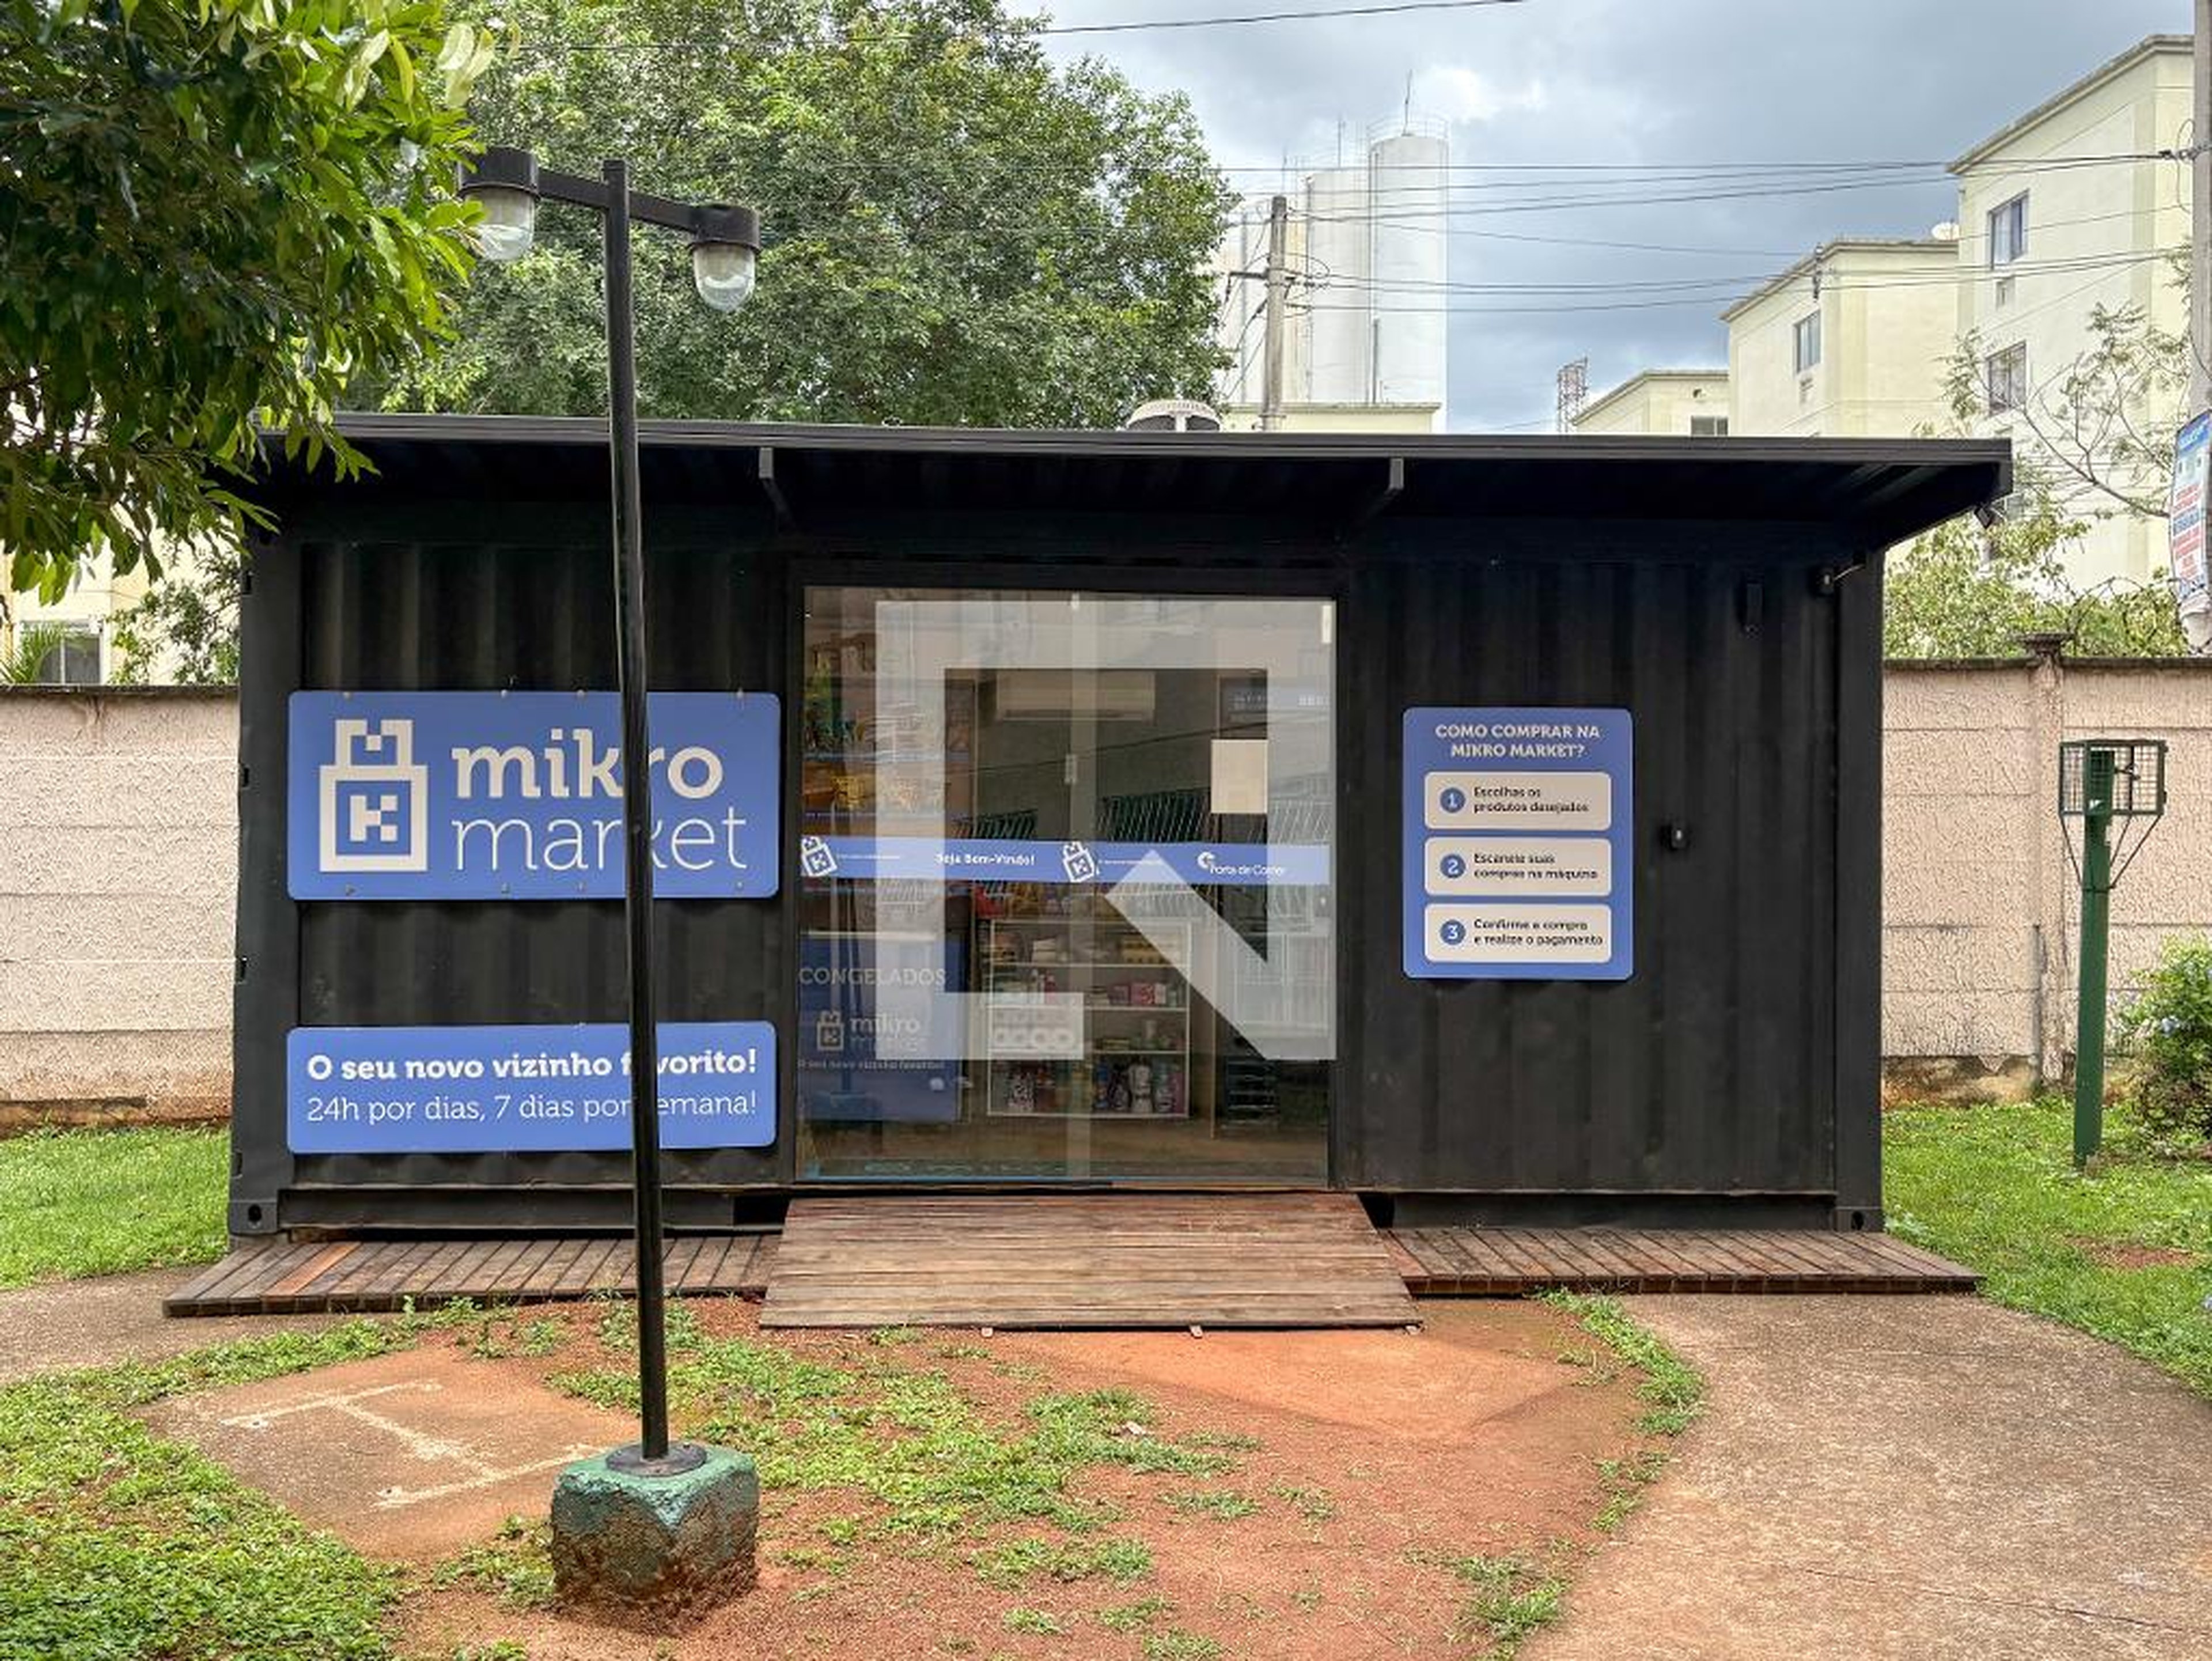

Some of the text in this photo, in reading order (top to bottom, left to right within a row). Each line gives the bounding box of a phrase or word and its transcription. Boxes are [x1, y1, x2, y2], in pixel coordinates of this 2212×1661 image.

[1435, 724, 1601, 739] COMO COMPRAR NA
[1451, 743, 1585, 758] MIKRO MARKET?
[1474, 787, 1541, 797] Escolhas os
[1447, 793, 1457, 807] 1
[1474, 803, 1527, 814] produtos
[1447, 859, 1459, 875] 2
[1528, 871, 1543, 879] na
[1474, 919, 1531, 929] Confirme
[1447, 924, 1459, 940] 3
[1484, 934, 1523, 944] realize
[1537, 934, 1604, 947] pagamento
[799, 968, 946, 986] CONGELADOS
[308, 1049, 756, 1080] O seu novo vizinho fvorito!
[308, 1089, 756, 1125] 24h por dias, 7 dias por emana!
